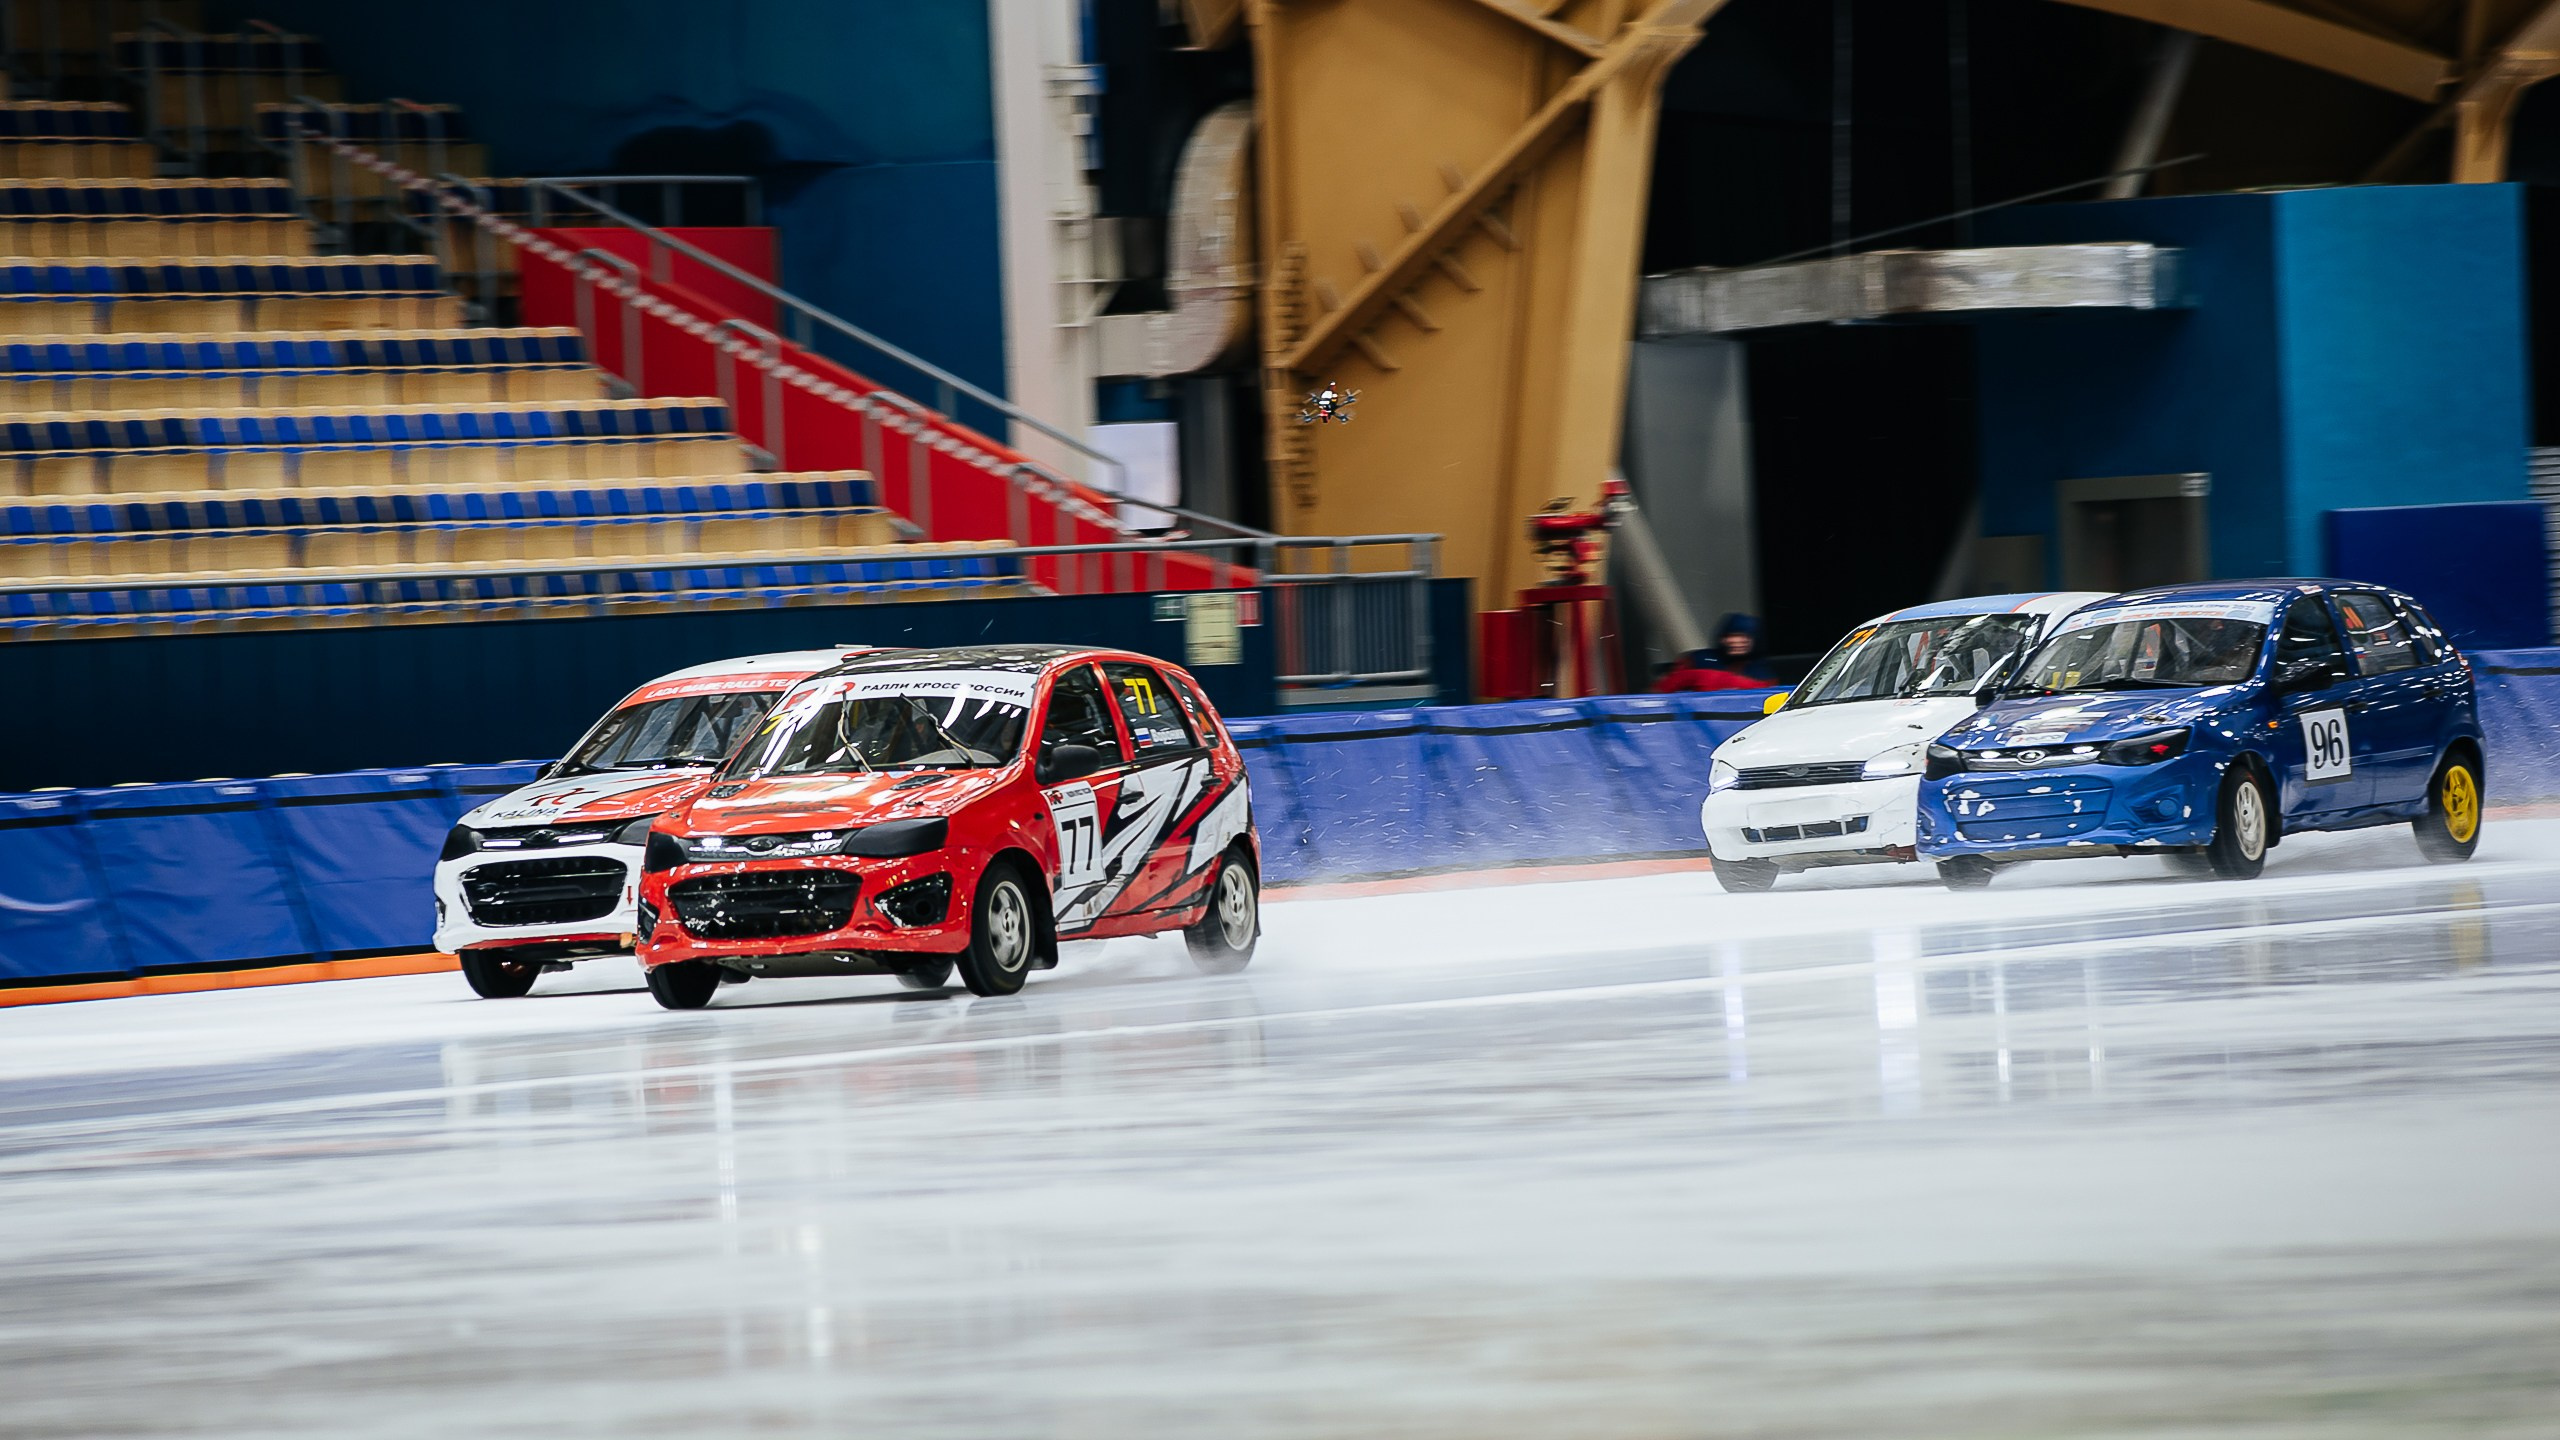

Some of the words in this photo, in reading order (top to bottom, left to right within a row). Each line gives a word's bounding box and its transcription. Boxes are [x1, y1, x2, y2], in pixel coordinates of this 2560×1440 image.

[721, 679, 768, 689] RALLY
[861, 682, 910, 692] РАЛЛИ
[913, 682, 961, 690] КРОСС
[1123, 678, 1157, 715] 77
[2311, 719, 2344, 769] 96
[490, 807, 560, 819] KALINA
[1061, 816, 1094, 875] 77
